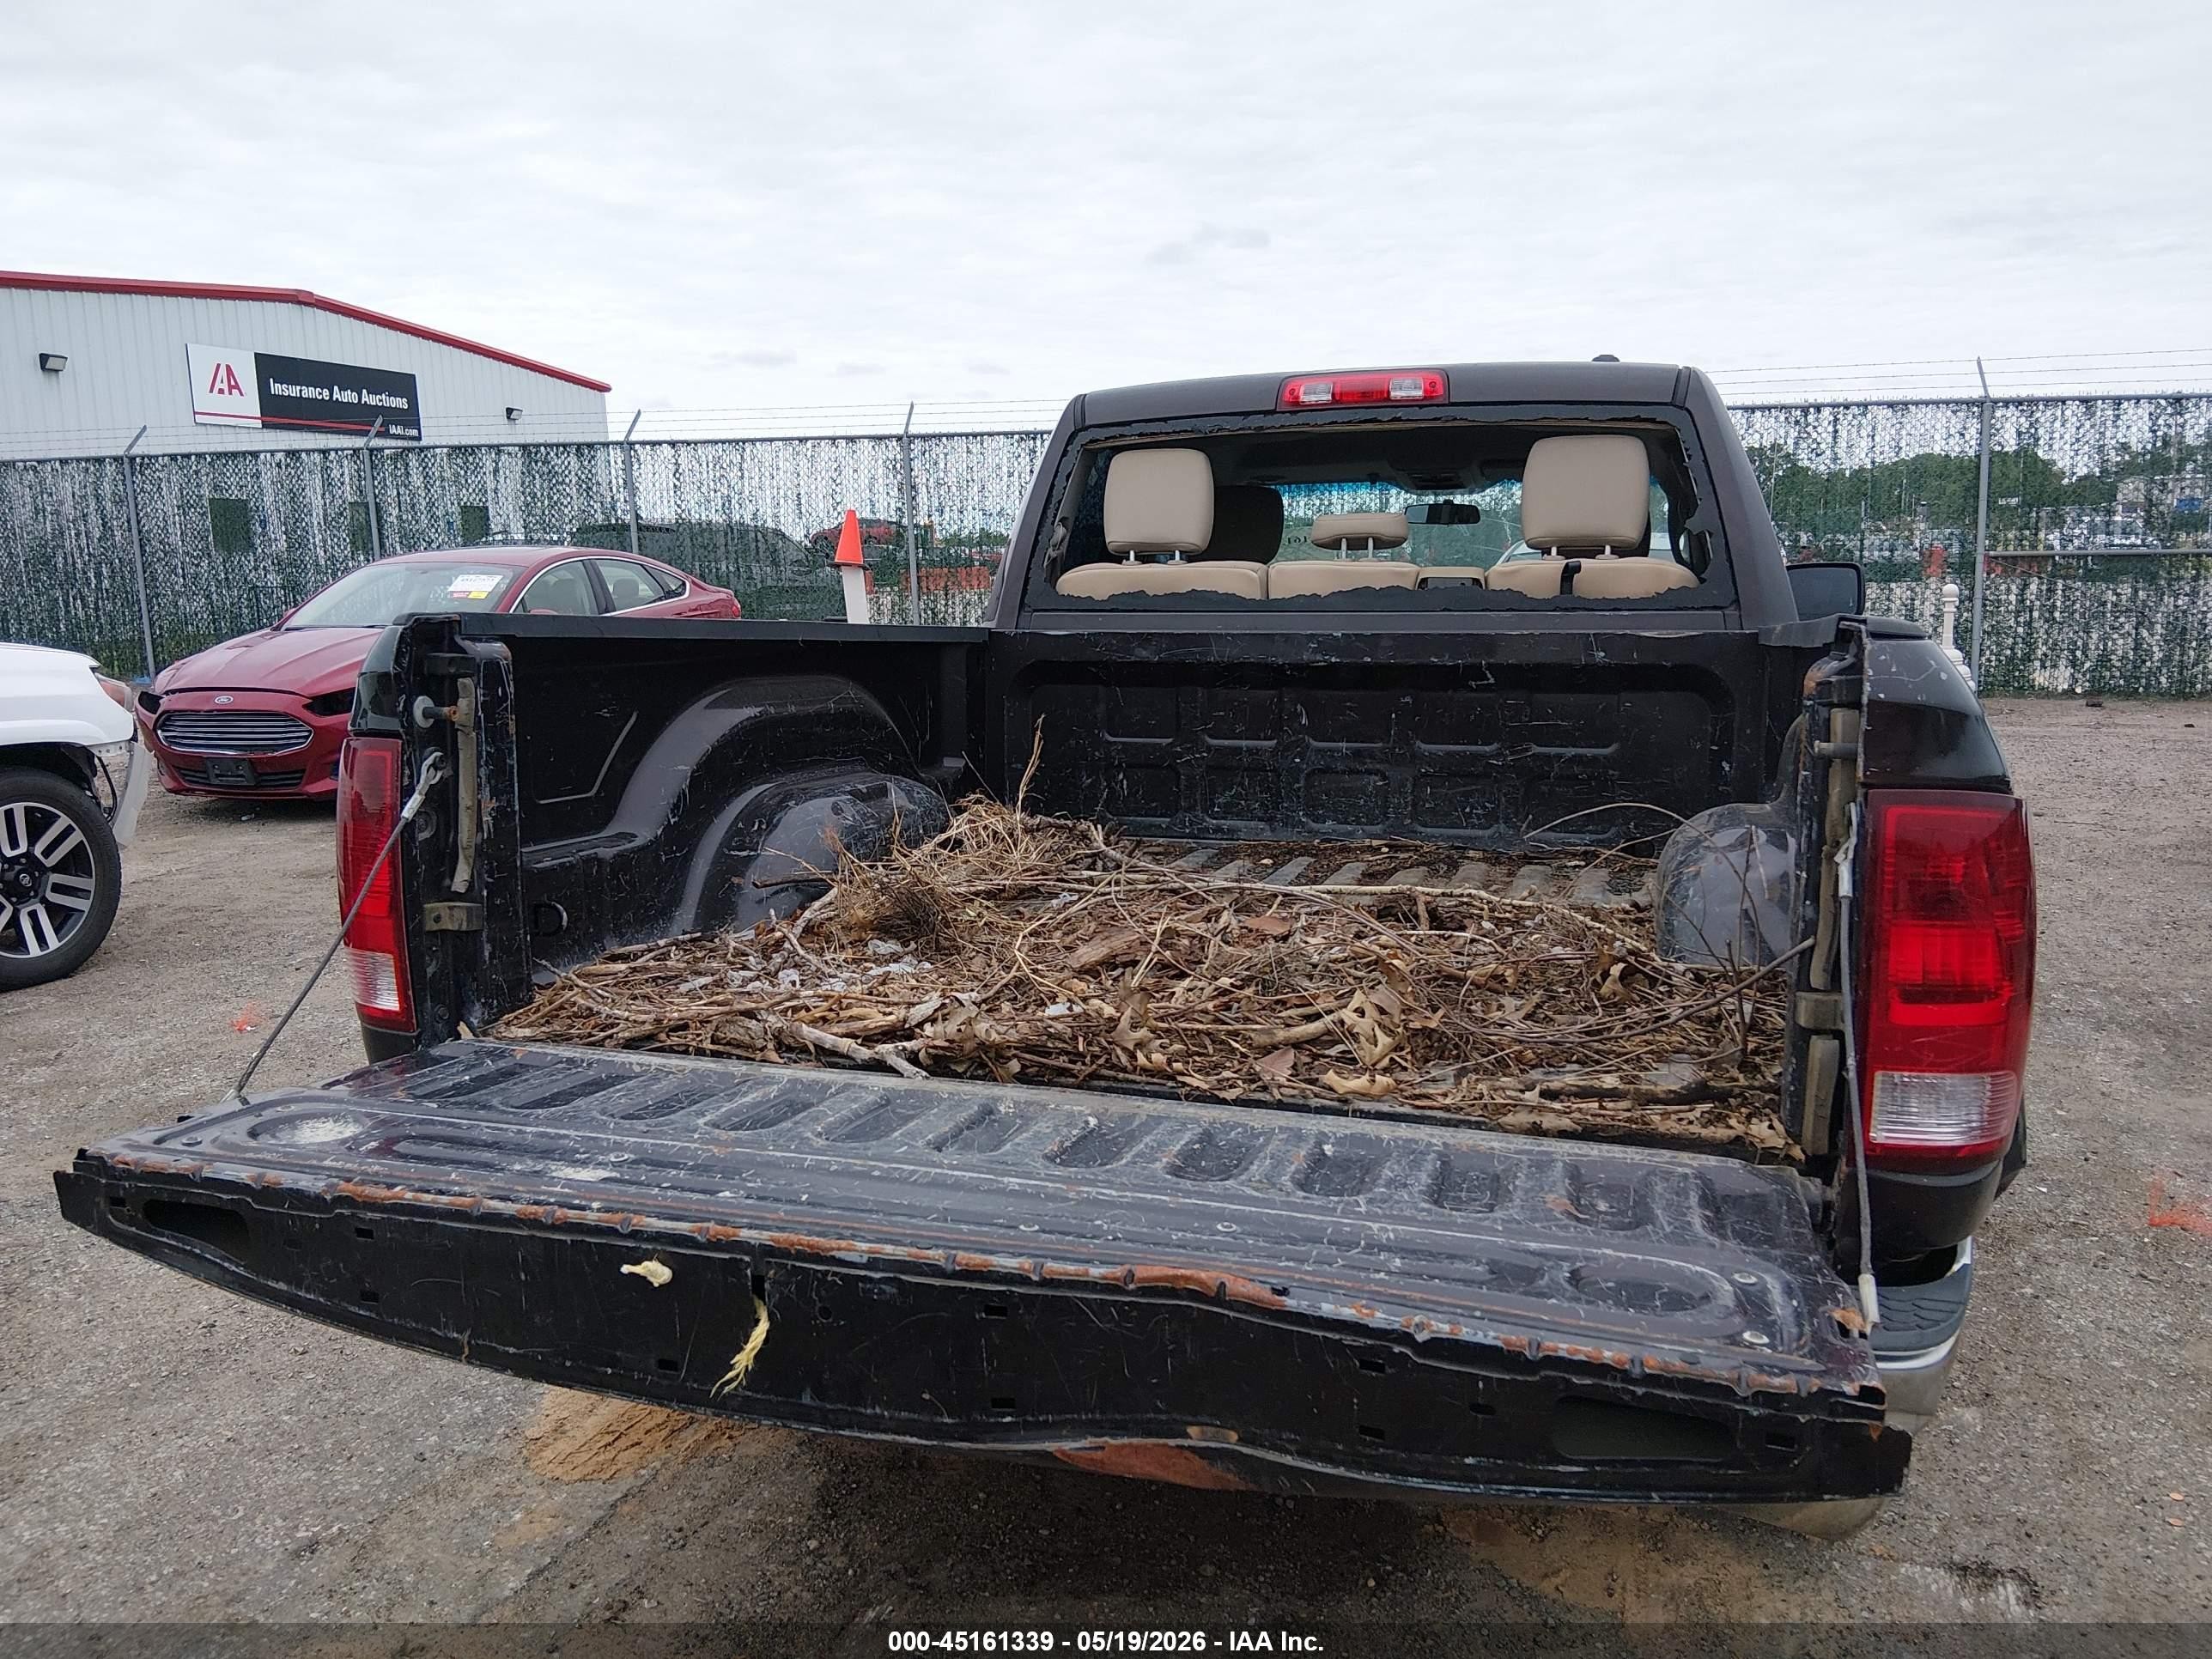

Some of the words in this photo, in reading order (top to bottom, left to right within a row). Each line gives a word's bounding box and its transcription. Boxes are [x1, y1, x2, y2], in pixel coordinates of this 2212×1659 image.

[269, 378, 330, 401] Insurance
[332, 386, 359, 404] Auto
[361, 389, 409, 410] Auctions
